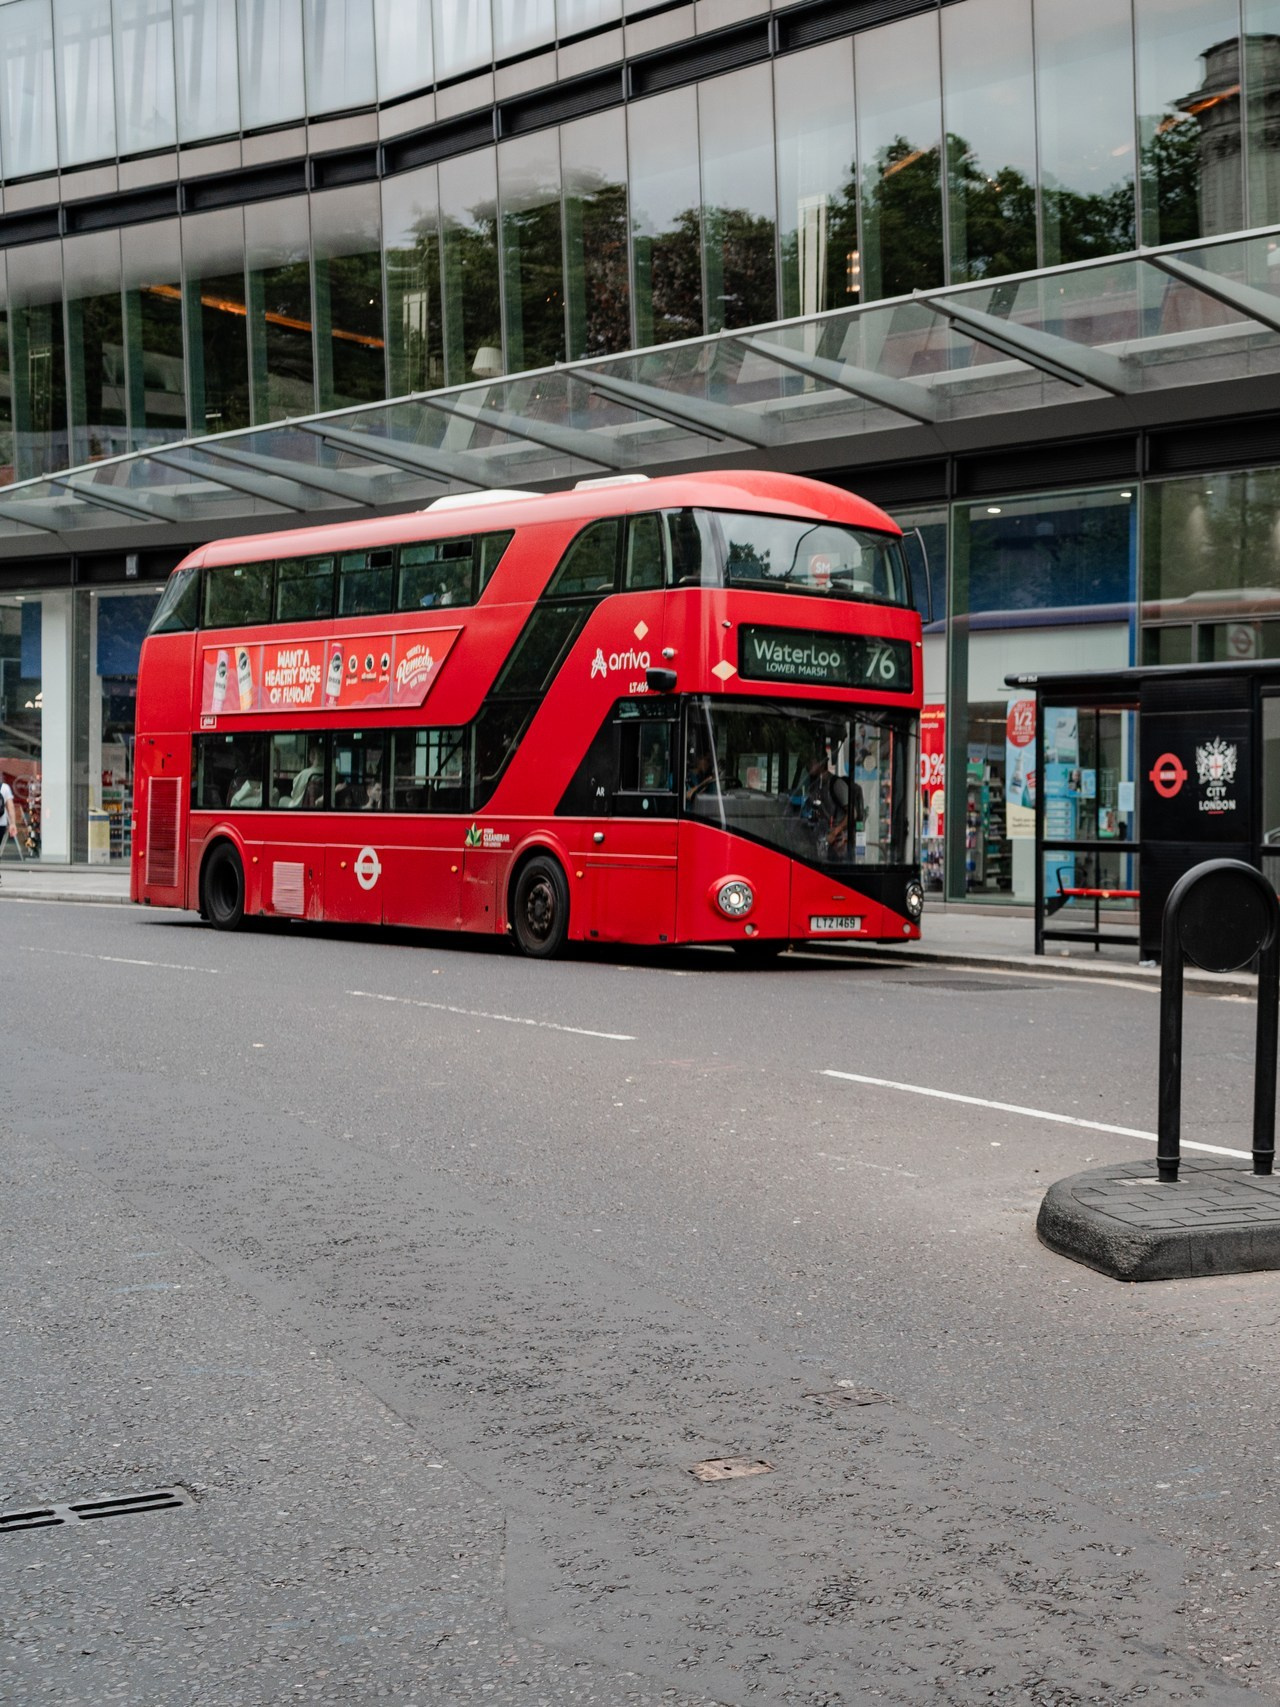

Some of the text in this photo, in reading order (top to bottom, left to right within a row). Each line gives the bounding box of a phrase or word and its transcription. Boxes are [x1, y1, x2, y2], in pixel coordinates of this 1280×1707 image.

[277, 649, 310, 668] WANT A
[609, 648, 651, 671] arriva
[753, 638, 896, 680] Waterloo 76
[265, 669, 298, 687] HEALTHY
[299, 665, 321, 684] DOSE
[396, 647, 434, 693] Remedy
[766, 662, 828, 677] LOWER MARSH
[270, 683, 315, 704] OF FLAVOUR?
[596, 786, 605, 797] AR
[1206, 786, 1227, 797] CITY
[1198, 800, 1236, 811] LONDON
